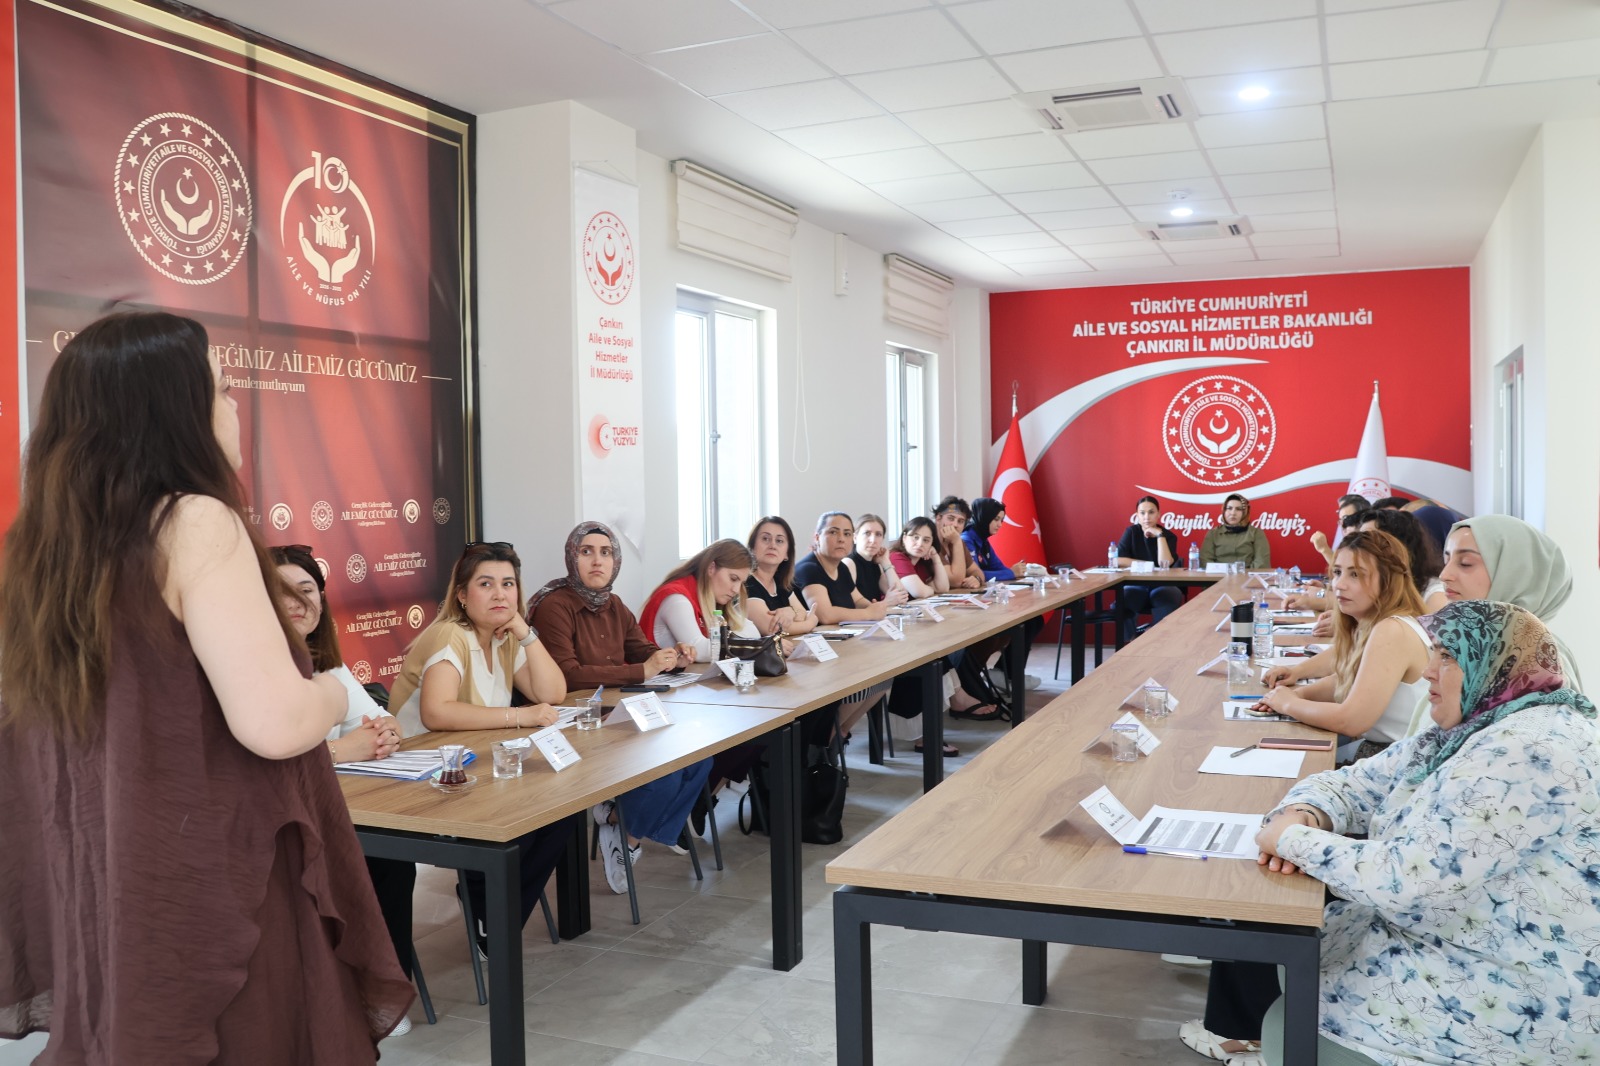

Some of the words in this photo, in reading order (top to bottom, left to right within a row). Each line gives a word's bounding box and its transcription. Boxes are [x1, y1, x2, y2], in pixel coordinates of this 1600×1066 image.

[160, 144, 176, 158] AİLE
[176, 144, 187, 153] VE
[188, 146, 214, 172] SOSYAL
[141, 152, 162, 214] CUMHURİYETİ
[311, 150, 349, 194] 10
[213, 170, 230, 222] HİZMETLER
[149, 216, 178, 250] TÜRKİYE
[196, 222, 229, 254] BAKANLIĞI
[286, 256, 302, 281] AİLE
[302, 282, 312, 296] VE
[316, 293, 345, 306] NÜFUS
[348, 289, 360, 302] ON
[358, 270, 372, 289] YILI
[1131, 296, 1196, 315] TÜRKİYE
[1199, 290, 1308, 312] CUMHURİYETİ
[1072, 320, 1106, 337] AİLE
[1108, 322, 1128, 336] VE
[1130, 318, 1188, 335] SOSYAL
[1191, 314, 1280, 332] HİZMETLER
[1283, 308, 1373, 328] BAKANLIĞI
[588, 332, 602, 344] Aile
[604, 336, 612, 345] ve
[612, 335, 633, 349] Sosyal
[1126, 338, 1189, 358] ÇANKIRI
[1192, 335, 1207, 352] İL
[1210, 331, 1314, 352] MÜDÜRLÜĞÜ
[208, 342, 276, 371] EĞİMİZ
[280, 350, 345, 377] AİLEMİZ
[348, 358, 418, 384] GÜCÜMÜZ
[596, 351, 628, 363] Hizmetler
[226, 375, 305, 394] ilemlemutluyum
[590, 365, 595, 378] İl
[596, 368, 633, 382] Müdürlüğü
[1196, 396, 1210, 407] AİLE
[1219, 395, 1242, 409] SOSYAL
[1161, 512, 1214, 537] Büyük
[1251, 512, 1310, 537] Aileyiz.
